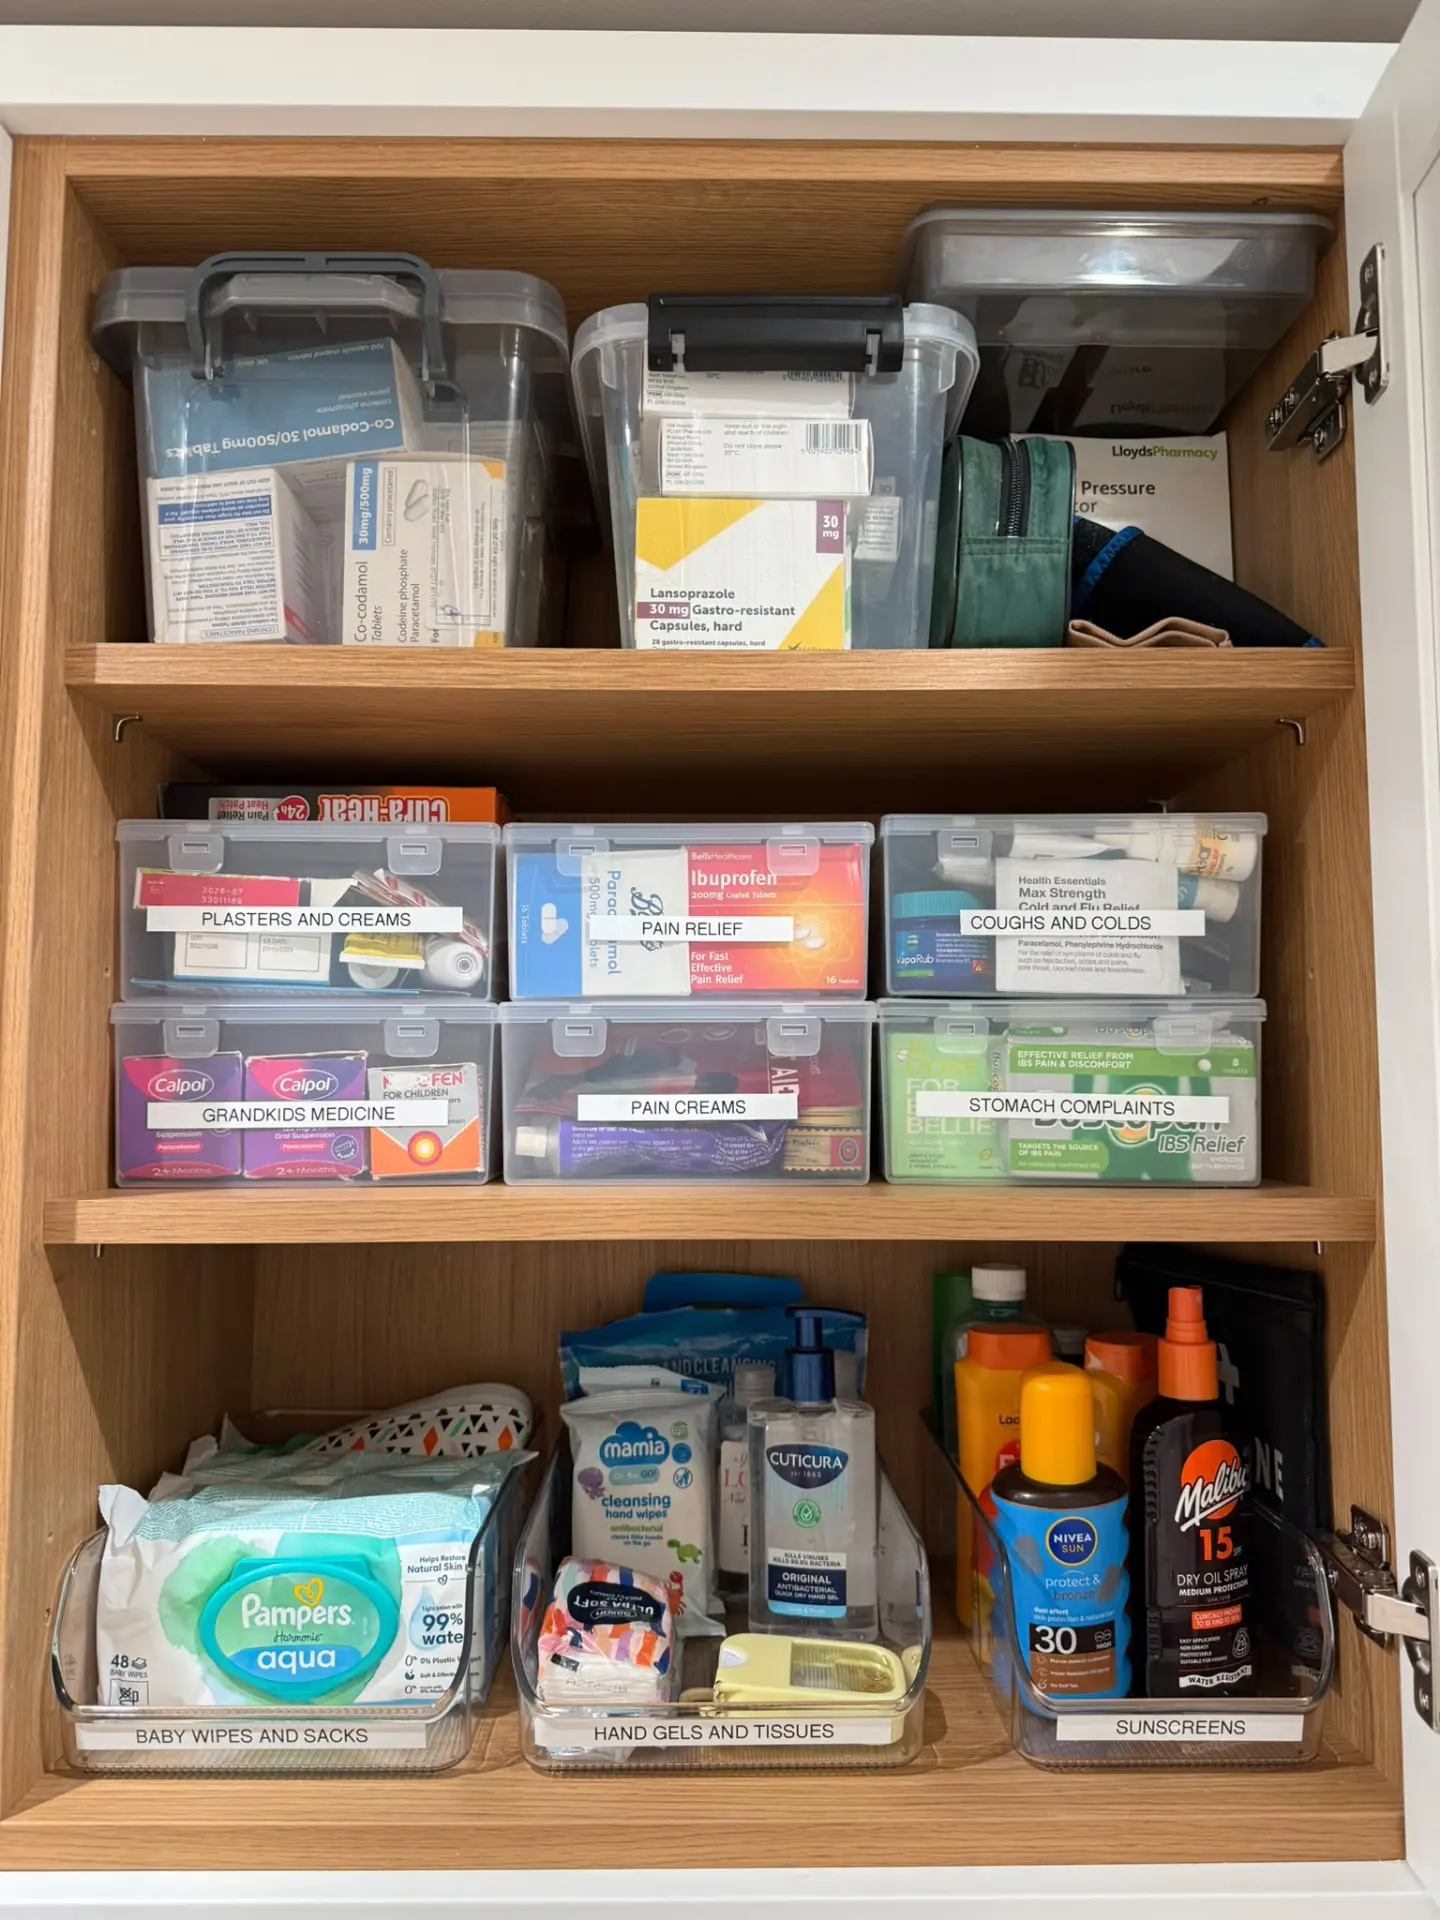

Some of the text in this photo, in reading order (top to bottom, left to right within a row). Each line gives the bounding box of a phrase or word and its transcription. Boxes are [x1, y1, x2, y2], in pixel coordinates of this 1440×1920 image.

[222, 417, 394, 450] Co-Codamol 30/500mg
[1111, 444, 1218, 461] LloydsPharmacy
[385, 469, 395, 513] paracetamol
[1080, 480, 1156, 496] Pressure
[359, 466, 374, 545] 30mg/500mg
[822, 515, 838, 528] 30
[822, 529, 840, 540] mg
[398, 549, 409, 643] Codeine phosphate
[650, 588, 735, 601] Lansoprazole
[354, 561, 368, 643] Co-codamol
[411, 583, 420, 642] Paracetamol
[649, 603, 796, 617] 30 mg Gastro-resistant
[372, 605, 383, 642] Tablets
[650, 620, 743, 632] Capsules, hard
[661, 639, 766, 647] gastro-resistant hard
[248, 799, 269, 810] Heat
[281, 802, 305, 817] 24h
[217, 810, 270, 822] Pain Relief
[691, 869, 777, 890] Ibuprofen
[1018, 876, 1106, 886] Health Essentials
[691, 891, 724, 901] 200mg
[1018, 887, 1106, 901] Max Strength
[1018, 902, 1140, 911] Cold and Flu Relief
[201, 912, 412, 927] PLASTERS AND CREAMS
[520, 904, 530, 944] 16 Tablets
[970, 914, 1151, 931] COUGHS AND COLDS
[641, 921, 743, 936] PAIN RELIEF
[1018, 940, 1164, 950] Paracetamol, Phenylephrine Hydrochloride
[691, 952, 729, 961] For Fast
[896, 953, 934, 966] VapoRub
[691, 963, 733, 973] Effective
[691, 974, 744, 984] Pain Relief
[826, 975, 837, 984] 16
[1017, 1050, 1134, 1061] EFFECTIVE RELIEF FROM
[1017, 1059, 1132, 1069] IBS PAIN & DISCOMFORT
[1232, 1058, 1240, 1067] 8
[155, 1077, 207, 1095] Calpol
[279, 1076, 332, 1095] Calpol
[906, 1077, 960, 1095] FOR
[383, 1088, 449, 1100] FOR CHILDREN
[630, 1098, 747, 1115] PAIN CREAMS
[968, 1097, 1175, 1116] STOMACH COMPLAINTS
[202, 1106, 396, 1123] GRANDKIDS MEDICINE
[156, 1130, 203, 1139] Suspension
[274, 1130, 336, 1140] Oral Suspension
[1018, 1142, 1099, 1152] TARGETS THE SOURCE
[1158, 1134, 1247, 1154] IBS Relief
[1043, 1150, 1062, 1158] PAIN
[151, 1166, 212, 1176] 2+ Months
[275, 1165, 338, 1176] 2+ Months
[603, 1432, 666, 1460] mamia
[769, 1451, 845, 1470] CUTICURA
[1174, 1457, 1247, 1527] Malibu
[601, 1492, 671, 1508] cleansing
[605, 1508, 668, 1520] hand wipes
[610, 1523, 664, 1533] antibacterial
[1053, 1532, 1093, 1545] NIVEA
[1199, 1525, 1234, 1561] 15
[1061, 1544, 1084, 1553] SUN
[419, 1555, 466, 1564] Helps Restore
[773, 1556, 842, 1568] KILLS BACTERIA
[784, 1552, 829, 1561] KILLS VIRUSES
[407, 1562, 463, 1574] Natural Skin
[782, 1572, 832, 1585] ORIGINAL
[1176, 1563, 1249, 1587] DRY OIL SPRAY
[777, 1582, 837, 1594] ANTIBACTERIAL
[1045, 1575, 1101, 1589] protect &
[1178, 1578, 1249, 1597] MEDIUM PROTECTION
[774, 1589, 793, 1598] QUICK
[241, 1592, 353, 1632] Pampers
[573, 1594, 655, 1617] ULTRA SOFT
[1049, 1608, 1069, 1616] effect
[422, 1612, 463, 1632] 99%
[1047, 1614, 1079, 1623] protection
[273, 1629, 320, 1643] Harmonie
[422, 1630, 464, 1646] wate
[1034, 1625, 1078, 1655] 30
[1192, 1635, 1221, 1644] APPLICATION
[1096, 1641, 1112, 1651] HIGH
[432, 1655, 456, 1664] Plastic
[1180, 1650, 1212, 1658] PHOTOSTABLE
[110, 1654, 129, 1668] 48
[256, 1649, 336, 1675] aqua
[110, 1669, 149, 1679] BABY WIPES
[1188, 1665, 1249, 1686] WATER RESISTANT
[594, 1723, 835, 1742] HAND GELS AND TISSUES
[1115, 1719, 1246, 1736] SUNSCREENS
[136, 1728, 369, 1744] BABY WIPES AND SACKS
